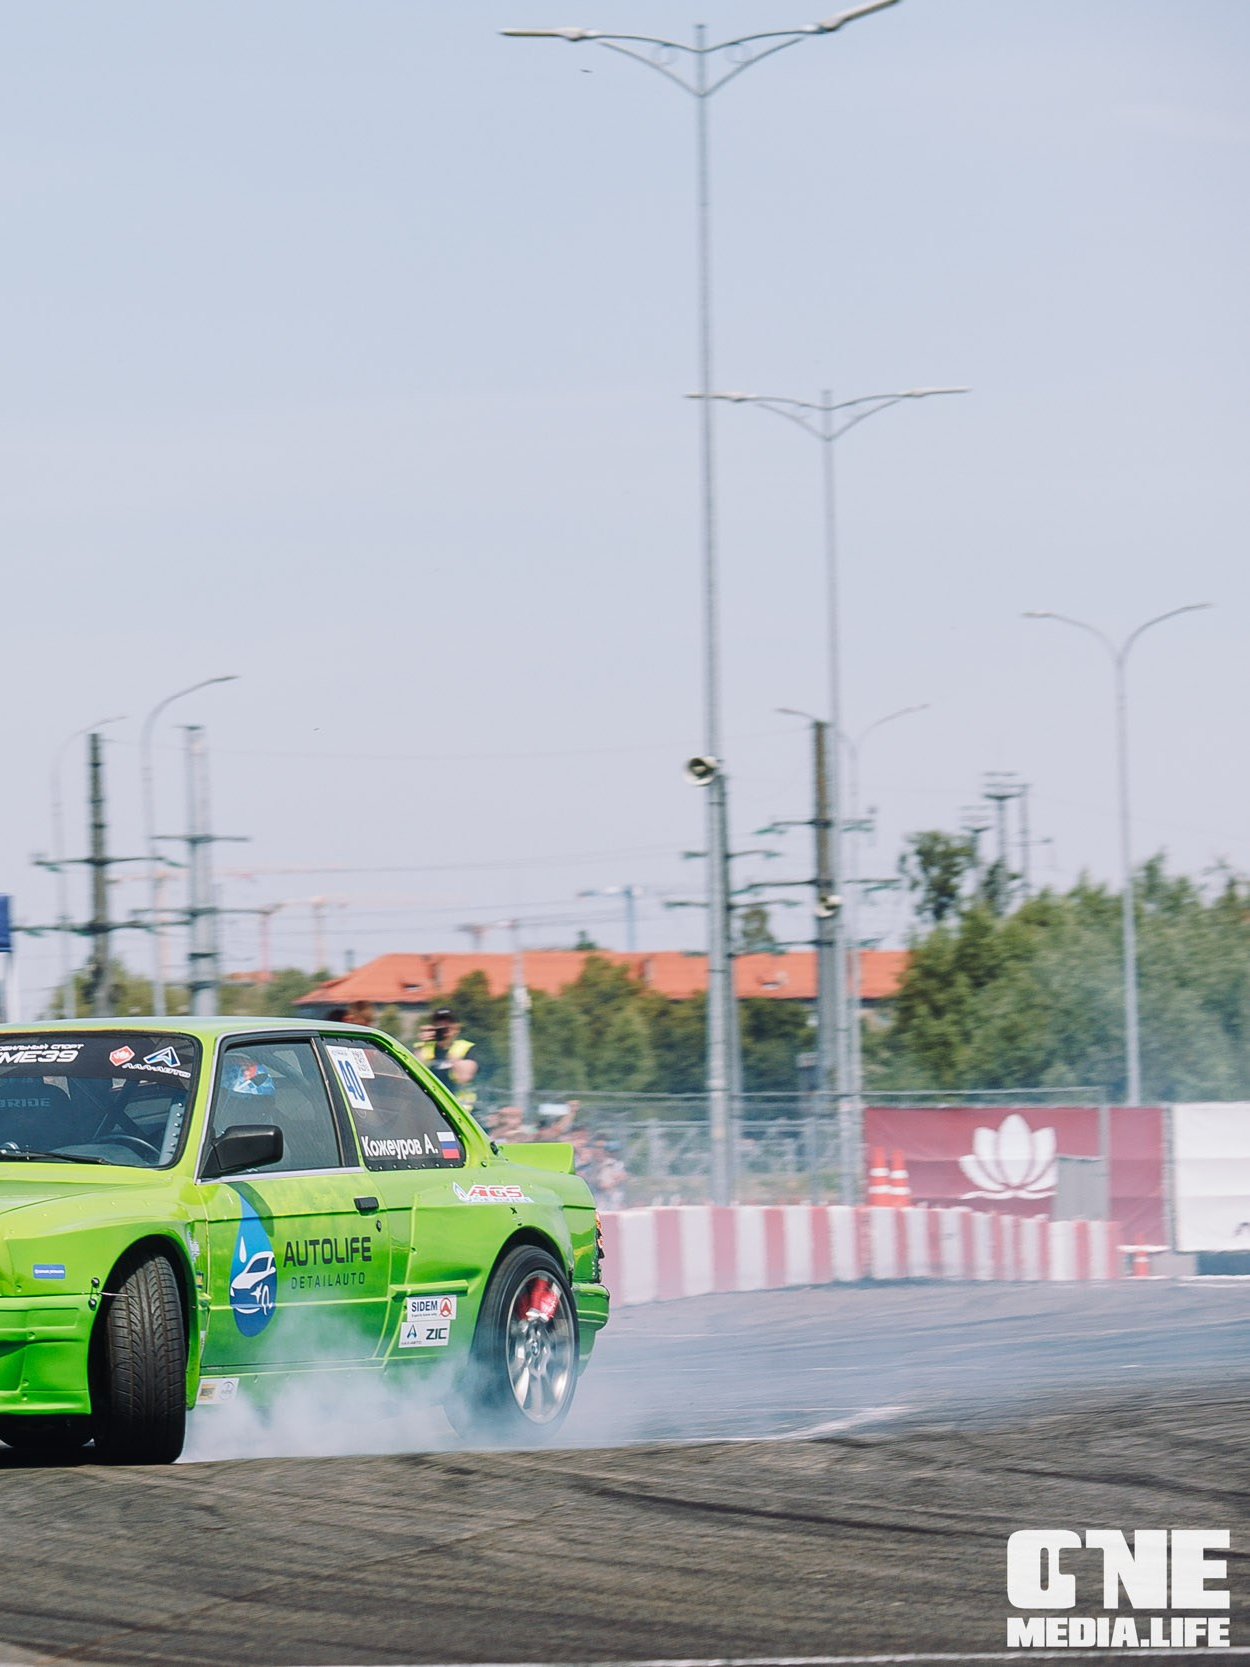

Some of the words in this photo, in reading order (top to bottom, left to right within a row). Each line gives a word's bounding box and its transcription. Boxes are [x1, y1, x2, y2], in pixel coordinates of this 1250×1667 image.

[337, 1060, 366, 1102] 40
[361, 1136, 423, 1160] Кожеуров
[424, 1133, 439, 1154] А.
[469, 1185, 523, 1198] AGS
[283, 1237, 372, 1268] AUTOLIFE
[291, 1272, 366, 1290] DETAILAUTO
[411, 1300, 438, 1313] SIDEM
[425, 1327, 449, 1341] ZIC
